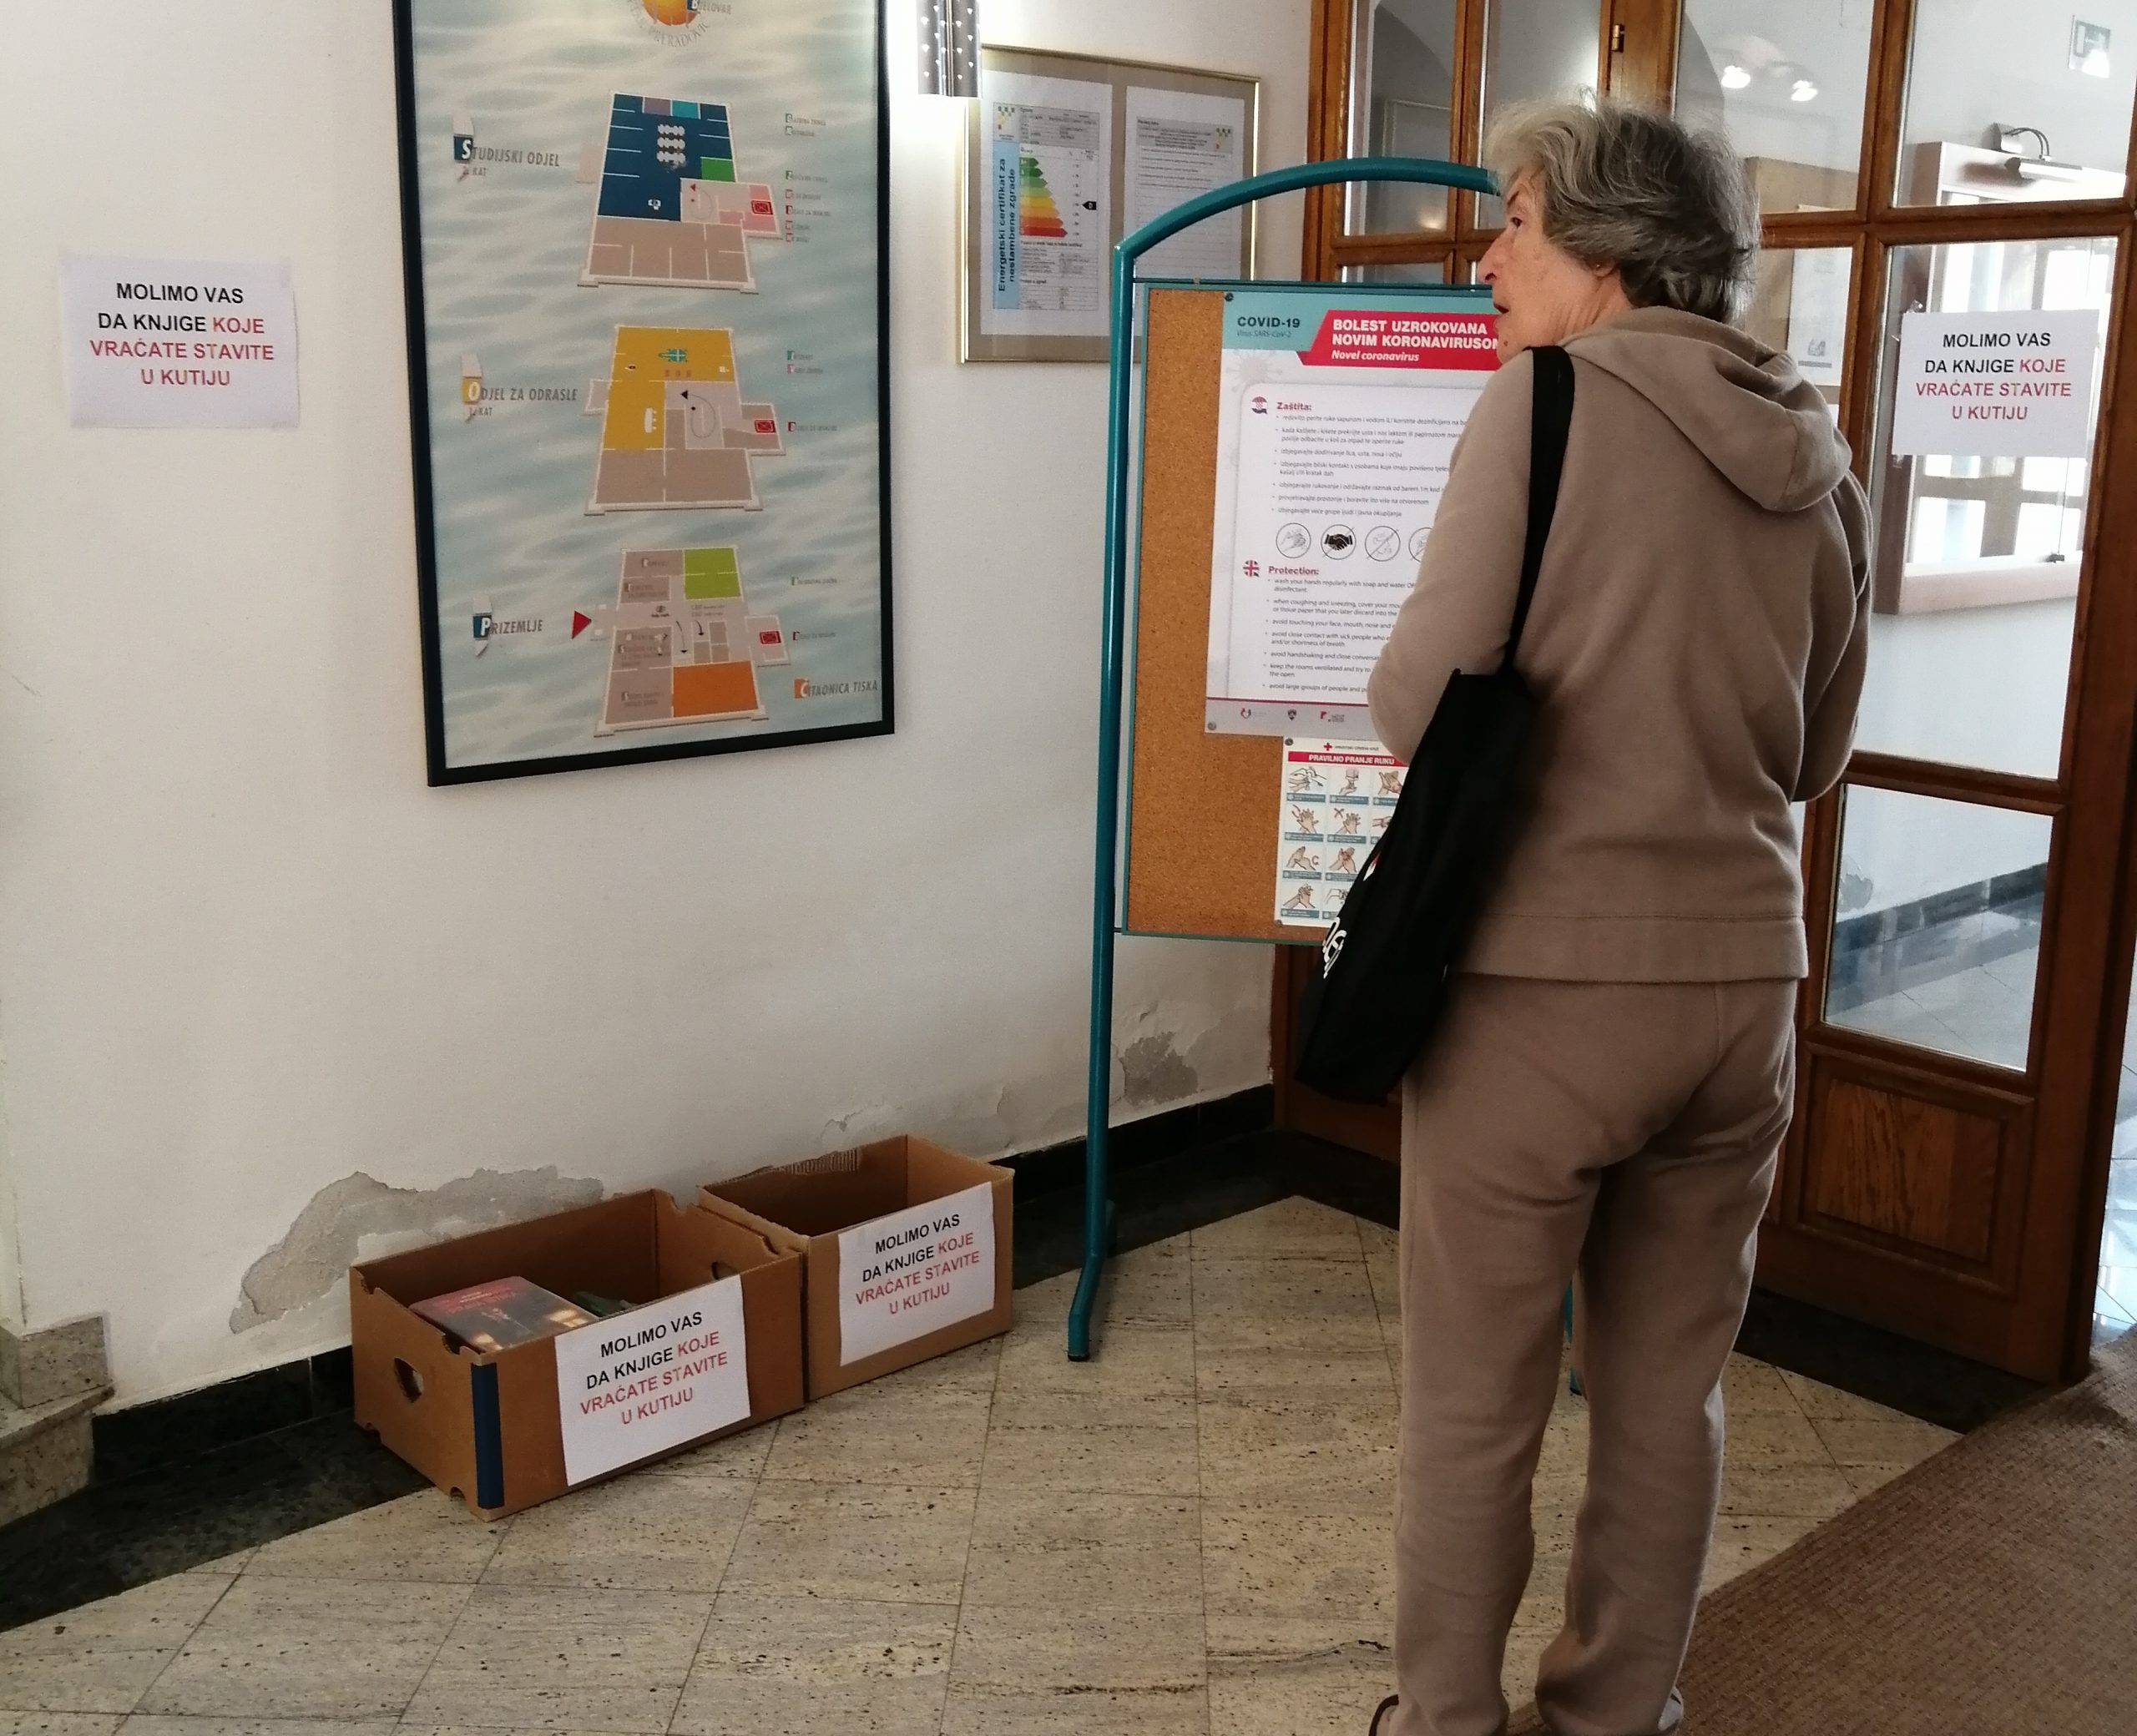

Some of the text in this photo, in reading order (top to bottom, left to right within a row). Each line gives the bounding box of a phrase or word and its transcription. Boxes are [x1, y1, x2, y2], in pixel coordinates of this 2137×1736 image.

[461, 139, 559, 167] STUDIJSKI ODJEL
[999, 159, 1006, 172] za
[1008, 169, 1018, 209] zgrade
[998, 230, 1008, 291] Energetski
[117, 283, 244, 304] MOLIMO VAS
[98, 313, 265, 334] DA KNJIGE KOJE
[1237, 316, 1301, 328] COVID-19
[1333, 319, 1488, 335] BOLEST UZROKOVANA
[89, 338, 274, 360] VRAĆATE STAVITE
[1332, 334, 1377, 346] NOVIM
[1942, 332, 2051, 347] MOLIMO VAS
[1331, 350, 1419, 361] Novel coronavirus
[1925, 359, 2066, 373] DA KNJIGE KOJE
[141, 369, 230, 386] U KUTIJU
[1916, 379, 2072, 396] VRAĆATE STAVITE
[467, 381, 578, 401] ODJEL ZA ODRASLE
[479, 407, 493, 416] KAT
[1277, 402, 1311, 411] Zaštita:
[1952, 406, 2028, 420] U KUTIJU
[1269, 566, 1319, 575] Protection:
[481, 618, 543, 636] PRIZEMLJE
[801, 678, 878, 698] ČITAONICA TISKA
[1308, 754, 1395, 765] PRAVILNO PRANJE RUKU
[875, 1214, 960, 1254] MOLIMO VAS
[862, 1232, 974, 1282] DA KNJIGE KOJE
[856, 1251, 980, 1305] VRAĆATE STAVITE
[889, 1282, 950, 1315] U KUTIJU
[600, 1311, 703, 1357] MOLIMO VAS
[586, 1330, 720, 1390] DA KNJIGE KOJE
[580, 1351, 728, 1415] VRAĆATE STAVITE
[621, 1387, 694, 1425] U KUTIJU
